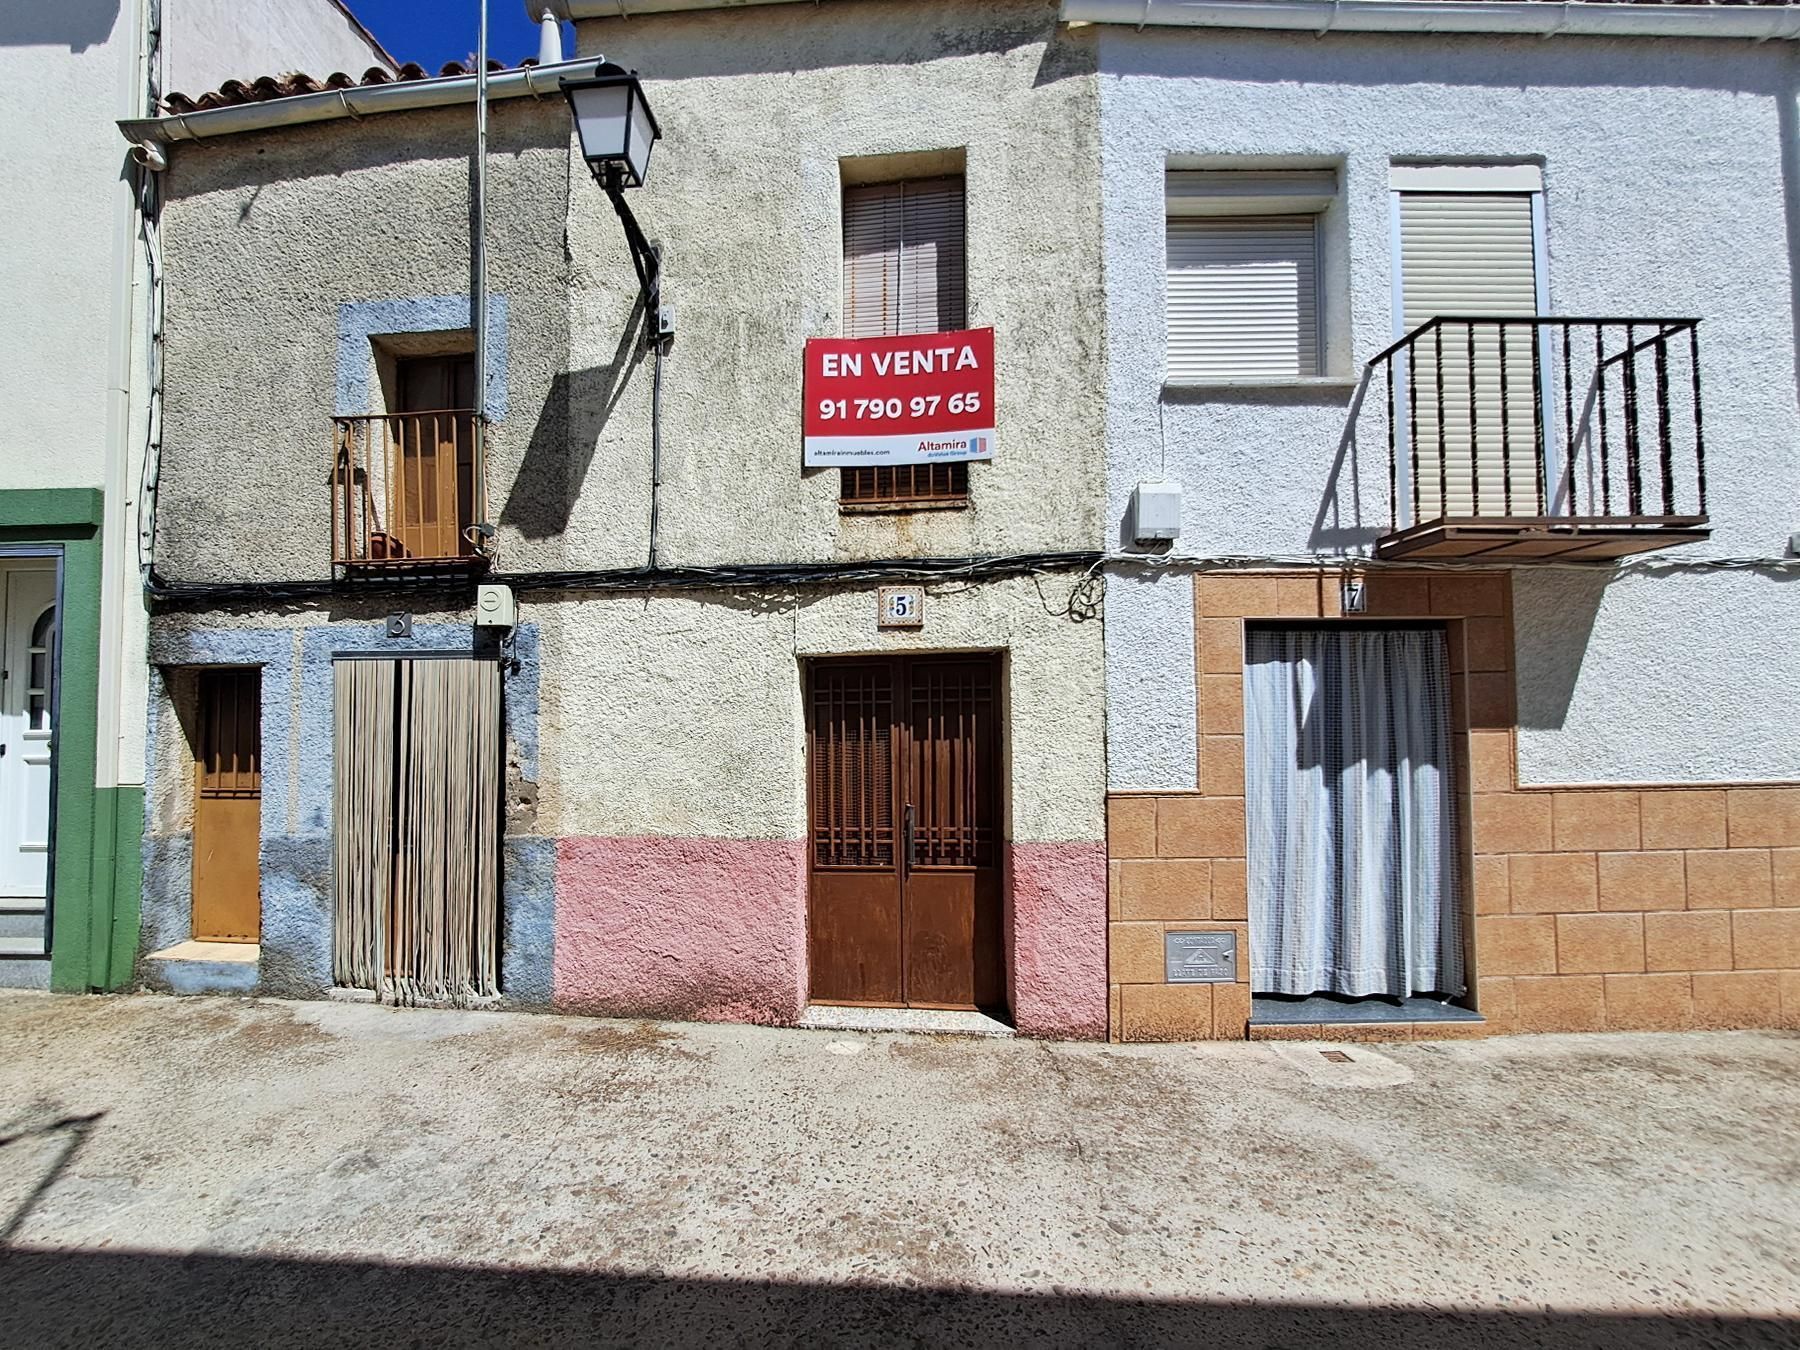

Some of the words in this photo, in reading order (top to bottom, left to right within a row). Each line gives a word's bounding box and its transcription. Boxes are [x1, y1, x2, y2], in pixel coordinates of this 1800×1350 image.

[822, 353, 862, 377] EN
[871, 345, 979, 376] VENTA
[819, 398, 847, 420] 91
[854, 398, 903, 420] 790
[909, 395, 942, 418] 97
[947, 391, 981, 415] 65
[814, 449, 890, 457] altamirainmuebles.com
[918, 439, 968, 452] Altamira
[895, 596, 907, 616] 5
[1347, 587, 1359, 608] 7
[391, 611, 406, 635] 3
